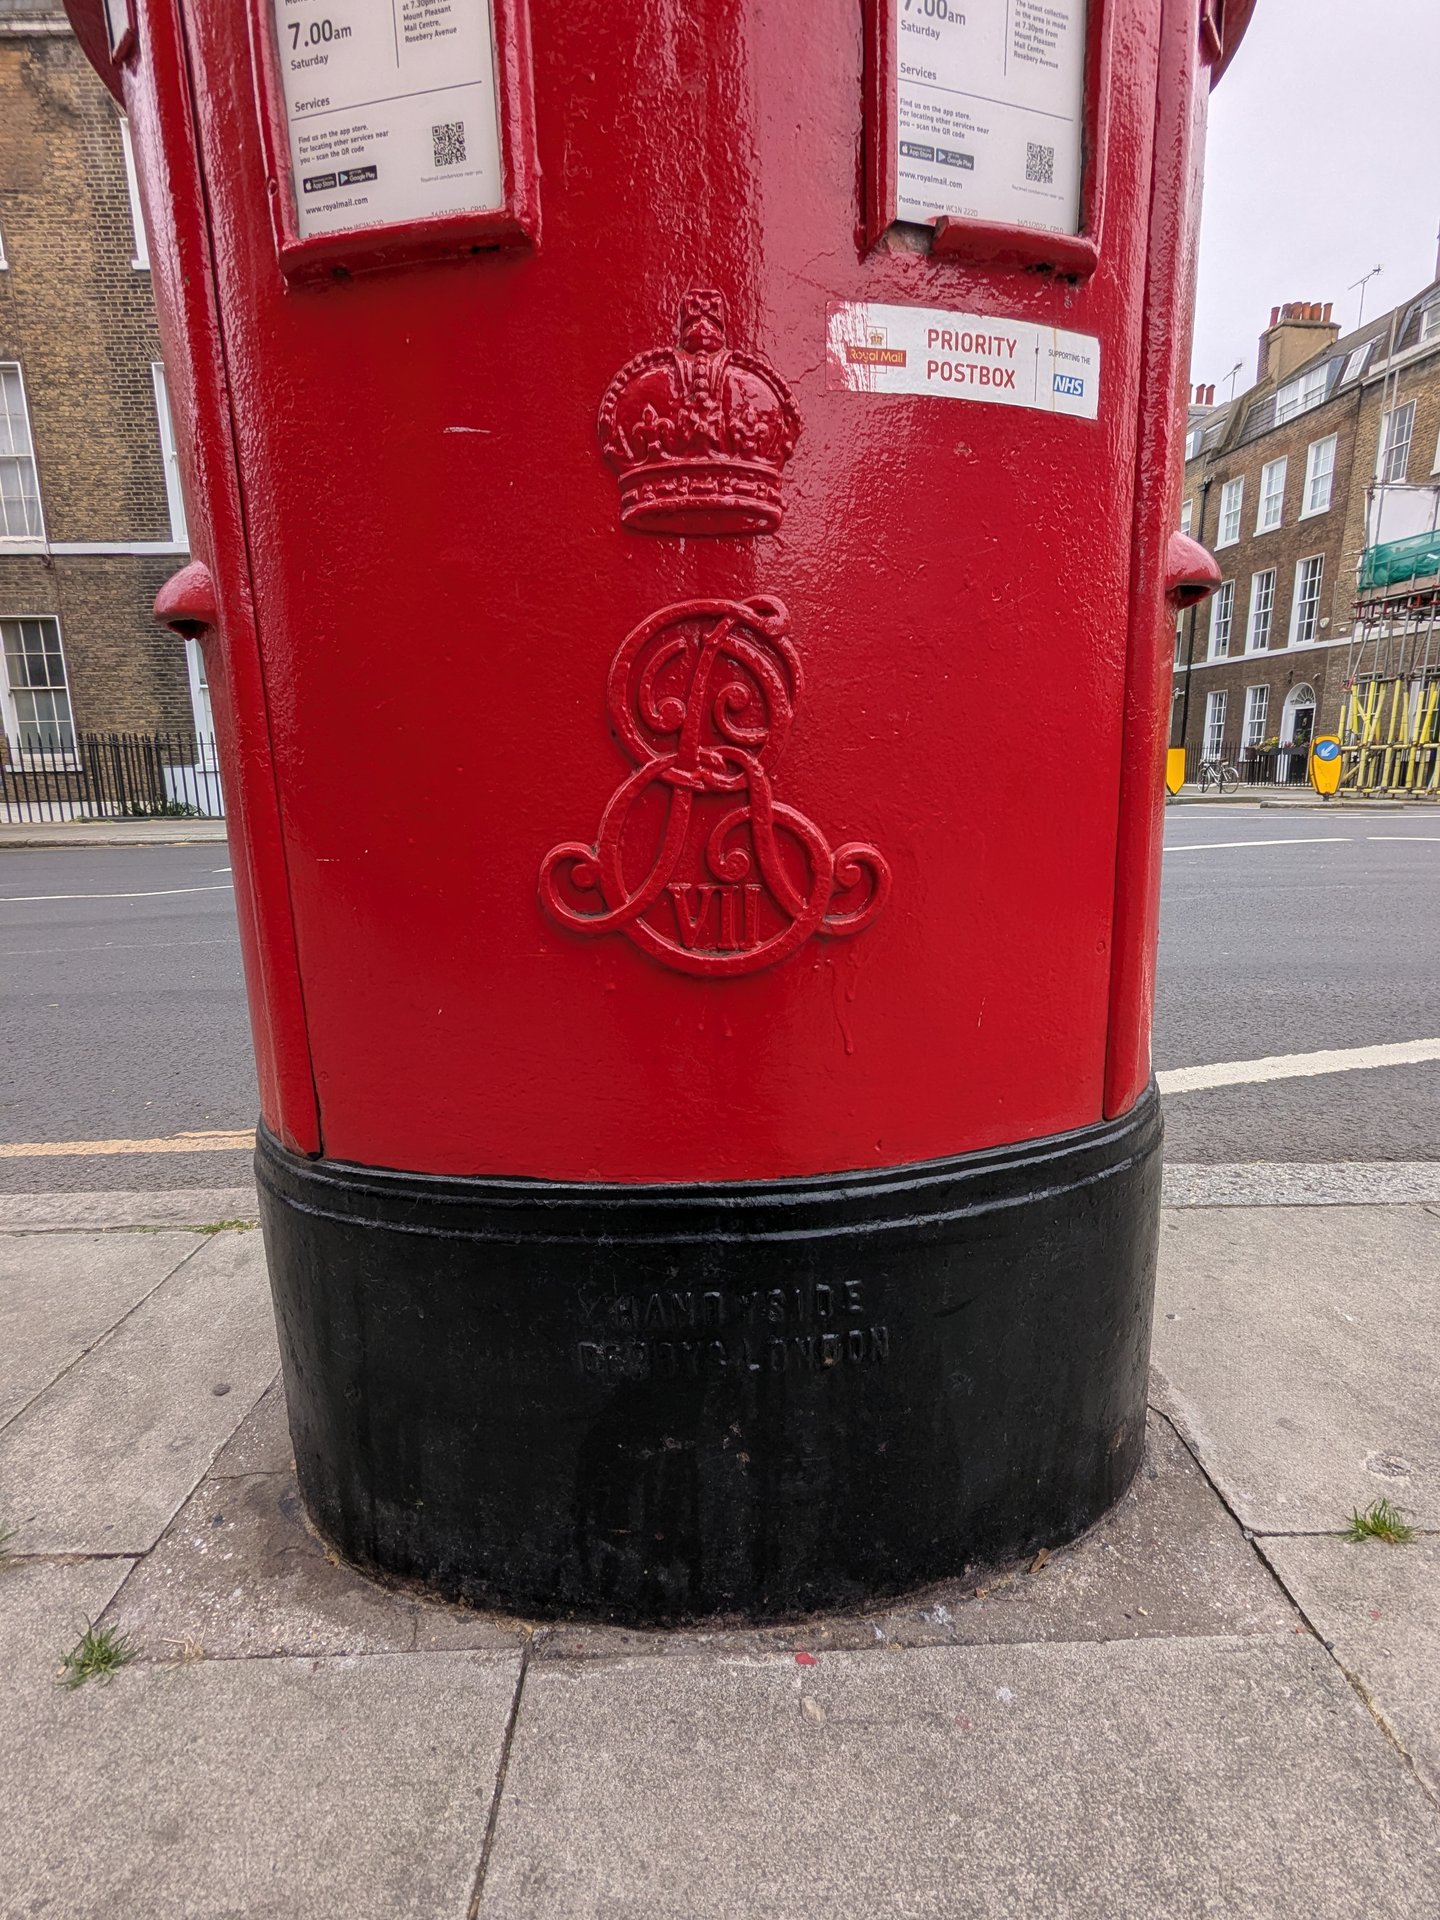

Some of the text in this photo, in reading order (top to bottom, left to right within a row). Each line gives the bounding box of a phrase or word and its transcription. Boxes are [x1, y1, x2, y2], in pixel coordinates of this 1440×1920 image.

[403, 5, 452, 21] Mount Pleasant
[1027, 2, 1043, 12] latest
[1044, 8, 1069, 20] collection
[288, 19, 352, 50] 7.00am
[404, 22, 417, 32] Mail
[405, 27, 457, 43] Rosebery Avenue
[900, 19, 940, 40] Saturday
[1014, 30, 1056, 48] Mount Pleasant
[290, 53, 329, 71] Saturday
[1014, 50, 1058, 69] Rosebery Avenue
[900, 62, 937, 80] Services
[295, 96, 330, 112] Services
[900, 97, 912, 107] Find
[931, 105, 941, 113] the
[943, 108, 953, 117] app
[899, 107, 989, 135] For locating other services near
[298, 136, 311, 144] Find
[328, 130, 338, 138] the
[340, 128, 350, 136] app
[916, 122, 929, 131] scan
[931, 125, 941, 133] the
[942, 127, 951, 136] QR
[952, 130, 965, 139] code
[299, 130, 389, 154] For locating other services near
[300, 158, 311, 166] you
[316, 153, 329, 161] scan
[330, 150, 340, 158] the
[341, 147, 350, 155] QR
[351, 145, 364, 154] code
[909, 149, 932, 159] App Store
[946, 156, 972, 168] Google Play
[312, 182, 323, 190] App
[322, 179, 335, 187] Store
[349, 173, 365, 182] Google
[366, 171, 376, 179] Play
[899, 170, 963, 189] www.royalmail.com
[305, 196, 369, 215] www.royalmail.com
[898, 194, 921, 206] Postbox
[922, 200, 944, 210] number
[926, 328, 1017, 359] PRIORITY
[850, 348, 904, 363] Royal Mail
[1048, 348, 1091, 366] SUPPORTING THE
[926, 360, 1016, 390] POSTBOX
[1053, 374, 1084, 396] NHS
[666, 882, 763, 951] VII
